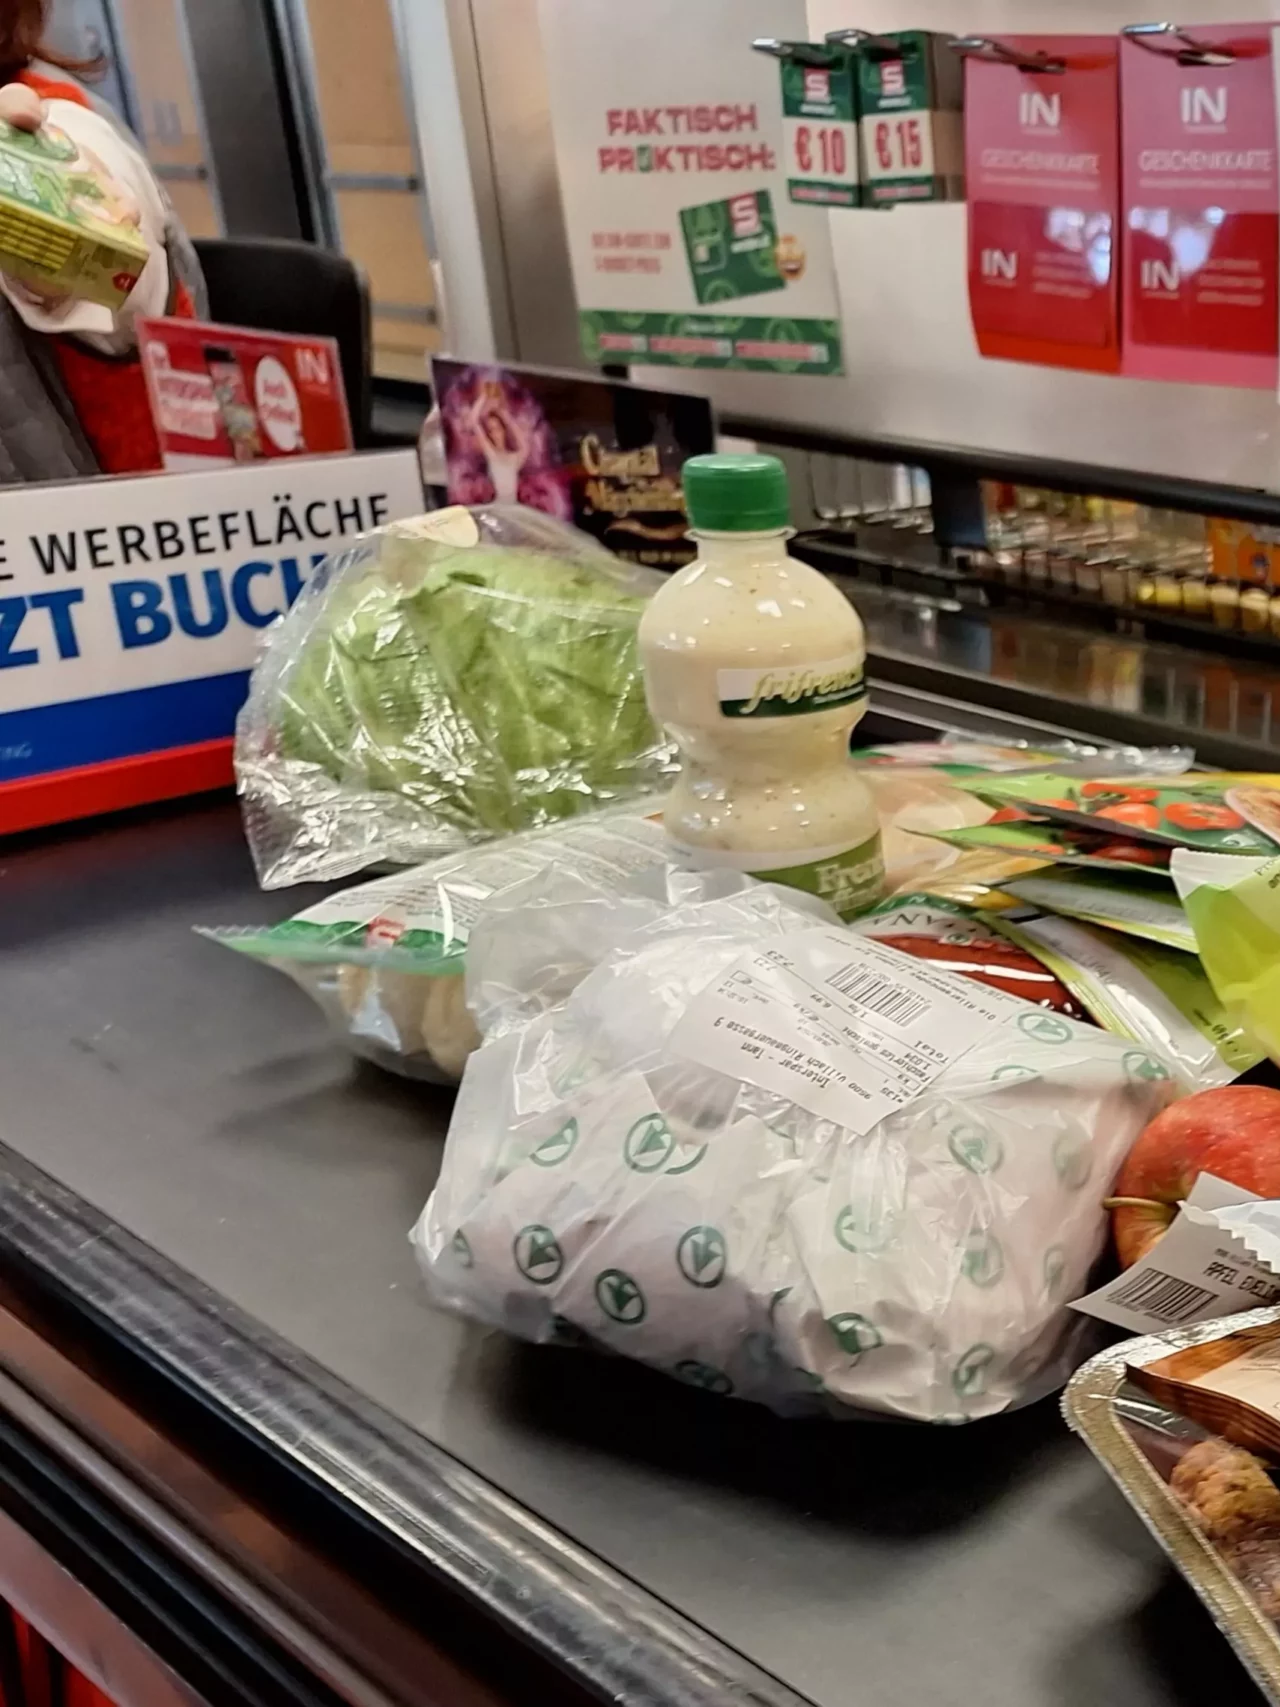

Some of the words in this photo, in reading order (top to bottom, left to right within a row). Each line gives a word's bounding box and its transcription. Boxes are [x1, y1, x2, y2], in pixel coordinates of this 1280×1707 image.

[606, 104, 757, 136] FAKTISCH
[1018, 91, 1061, 127] IN
[1180, 86, 1228, 124] IN
[794, 126, 812, 173] €
[818, 128, 846, 175] 10
[875, 122, 892, 169] €
[897, 118, 923, 168] 15
[30, 493, 389, 576] WERBEFLÄCHE
[713, 1016, 725, 1029] 9
[806, 1056, 847, 1083] Villach
[914, 1040, 949, 1065] Total
[779, 1057, 831, 1089] Interspar
